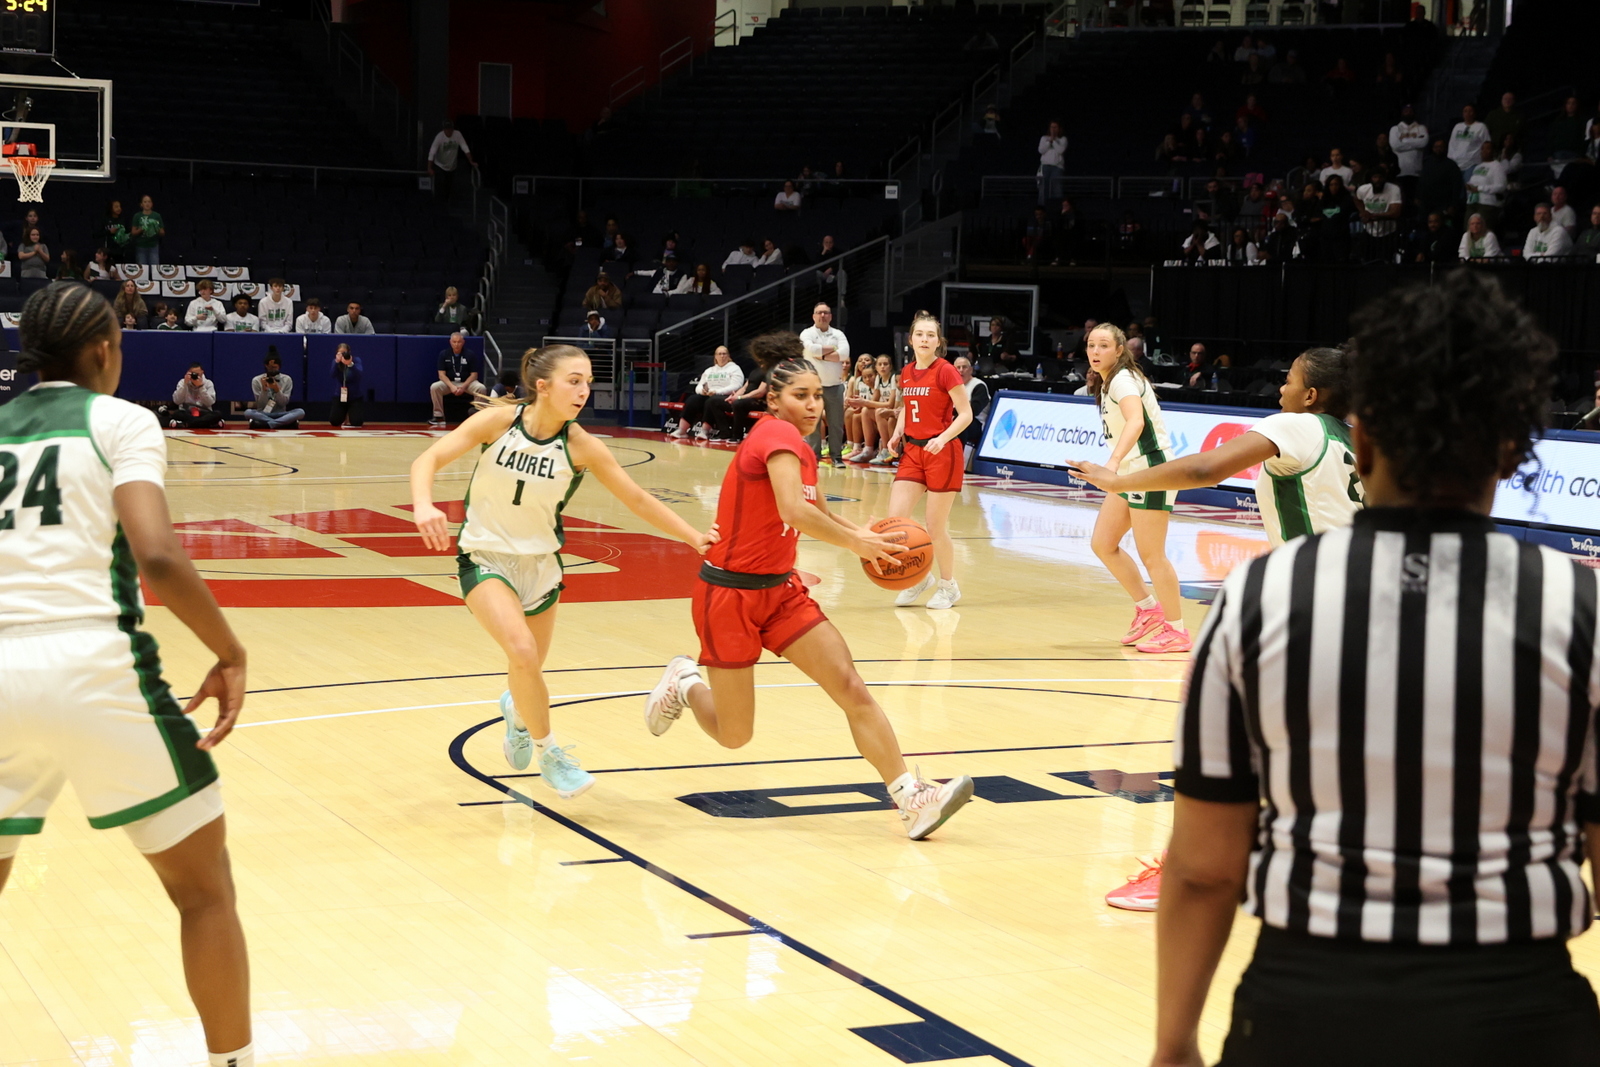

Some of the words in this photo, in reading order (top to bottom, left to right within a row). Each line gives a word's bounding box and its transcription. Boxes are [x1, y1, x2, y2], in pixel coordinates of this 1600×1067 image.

[0, 369, 17, 381] er
[909, 400, 920, 423] 2
[1016, 421, 1055, 442] health
[1056, 426, 1096, 447] action
[495, 445, 555, 480] LAUREL
[512, 479, 526, 506] 1
[882, 551, 926, 576] Rawlings
